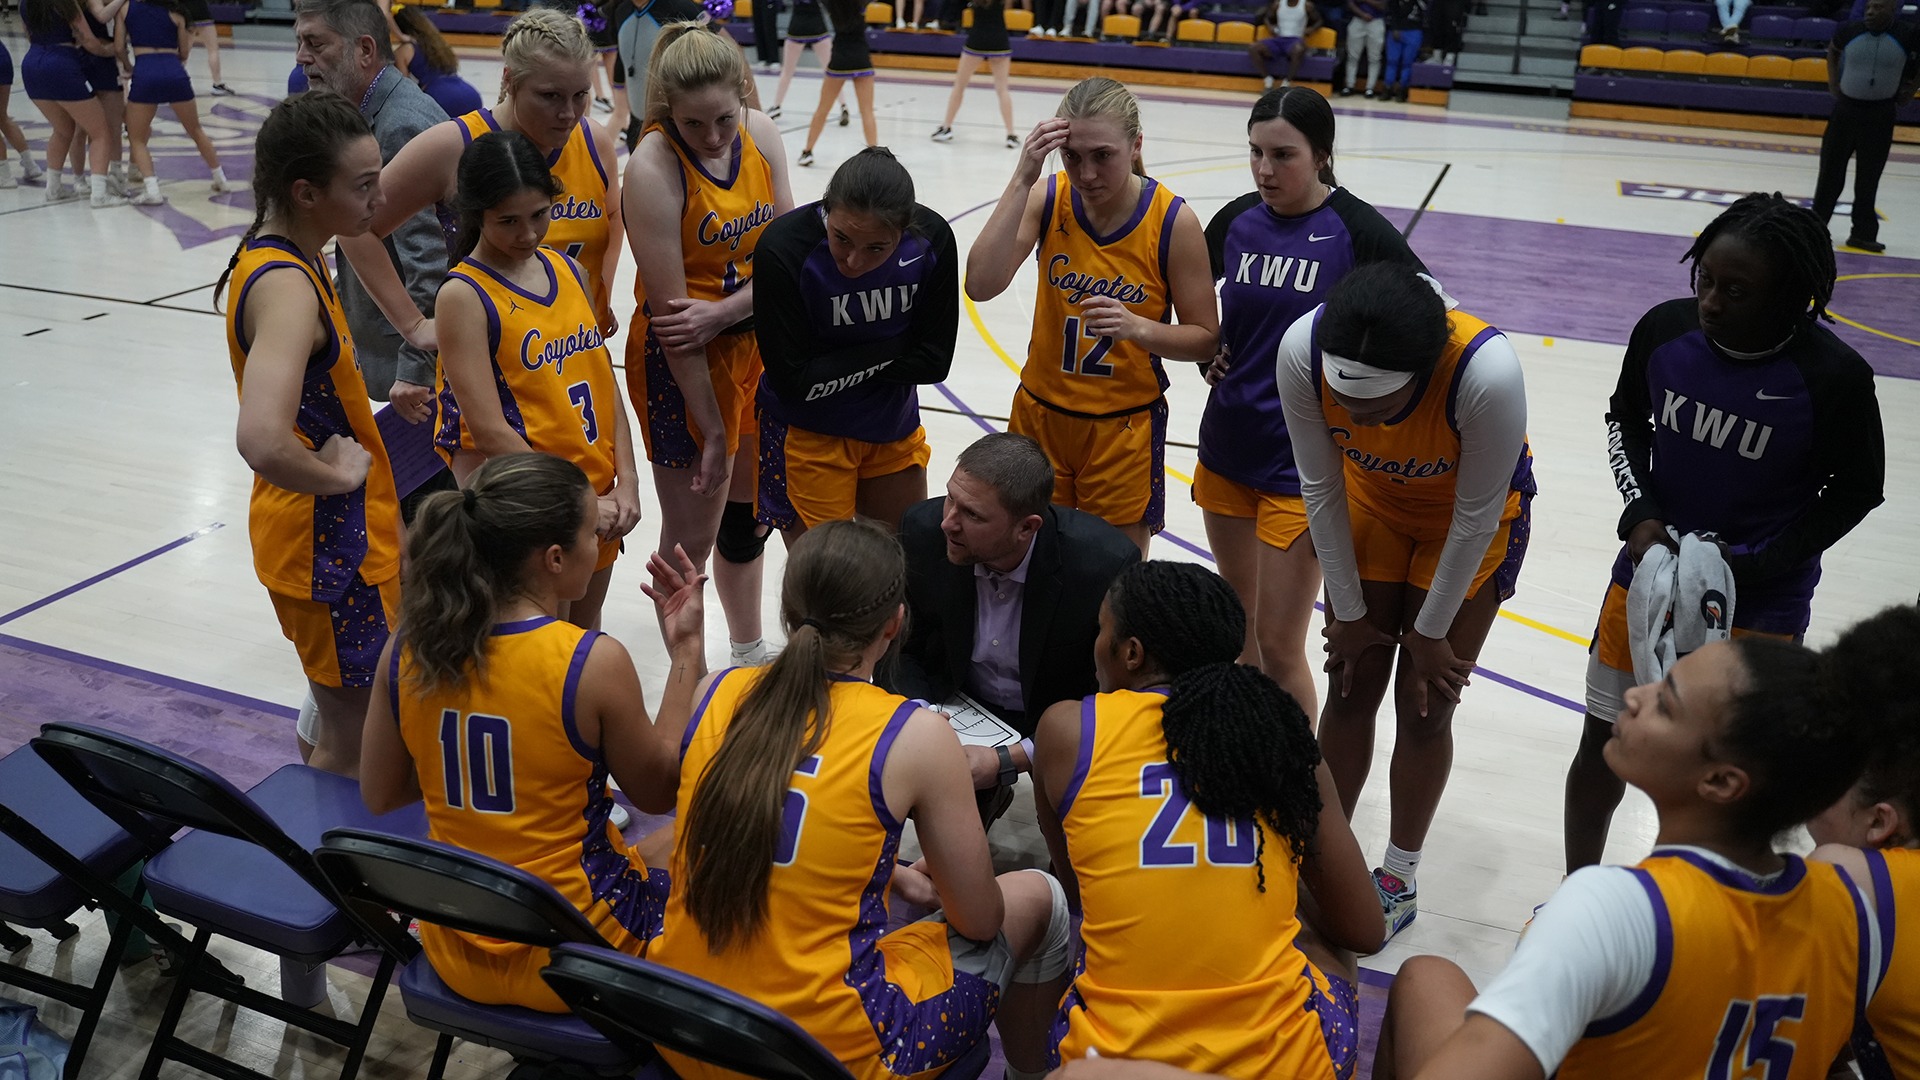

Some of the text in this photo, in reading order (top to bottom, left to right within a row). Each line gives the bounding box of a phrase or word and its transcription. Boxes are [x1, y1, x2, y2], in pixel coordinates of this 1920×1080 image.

[551, 195, 602, 221] otes
[1048, 253, 1149, 304] Coyotes
[1235, 252, 1320, 293] KWU
[830, 283, 919, 326] KWU
[520, 321, 605, 376] Coyotes
[1060, 315, 1115, 377] 12
[567, 380, 599, 445] 3
[1661, 388, 1773, 460] KWU
[438, 707, 516, 815] 10
[1704, 993, 1808, 1080] 15
